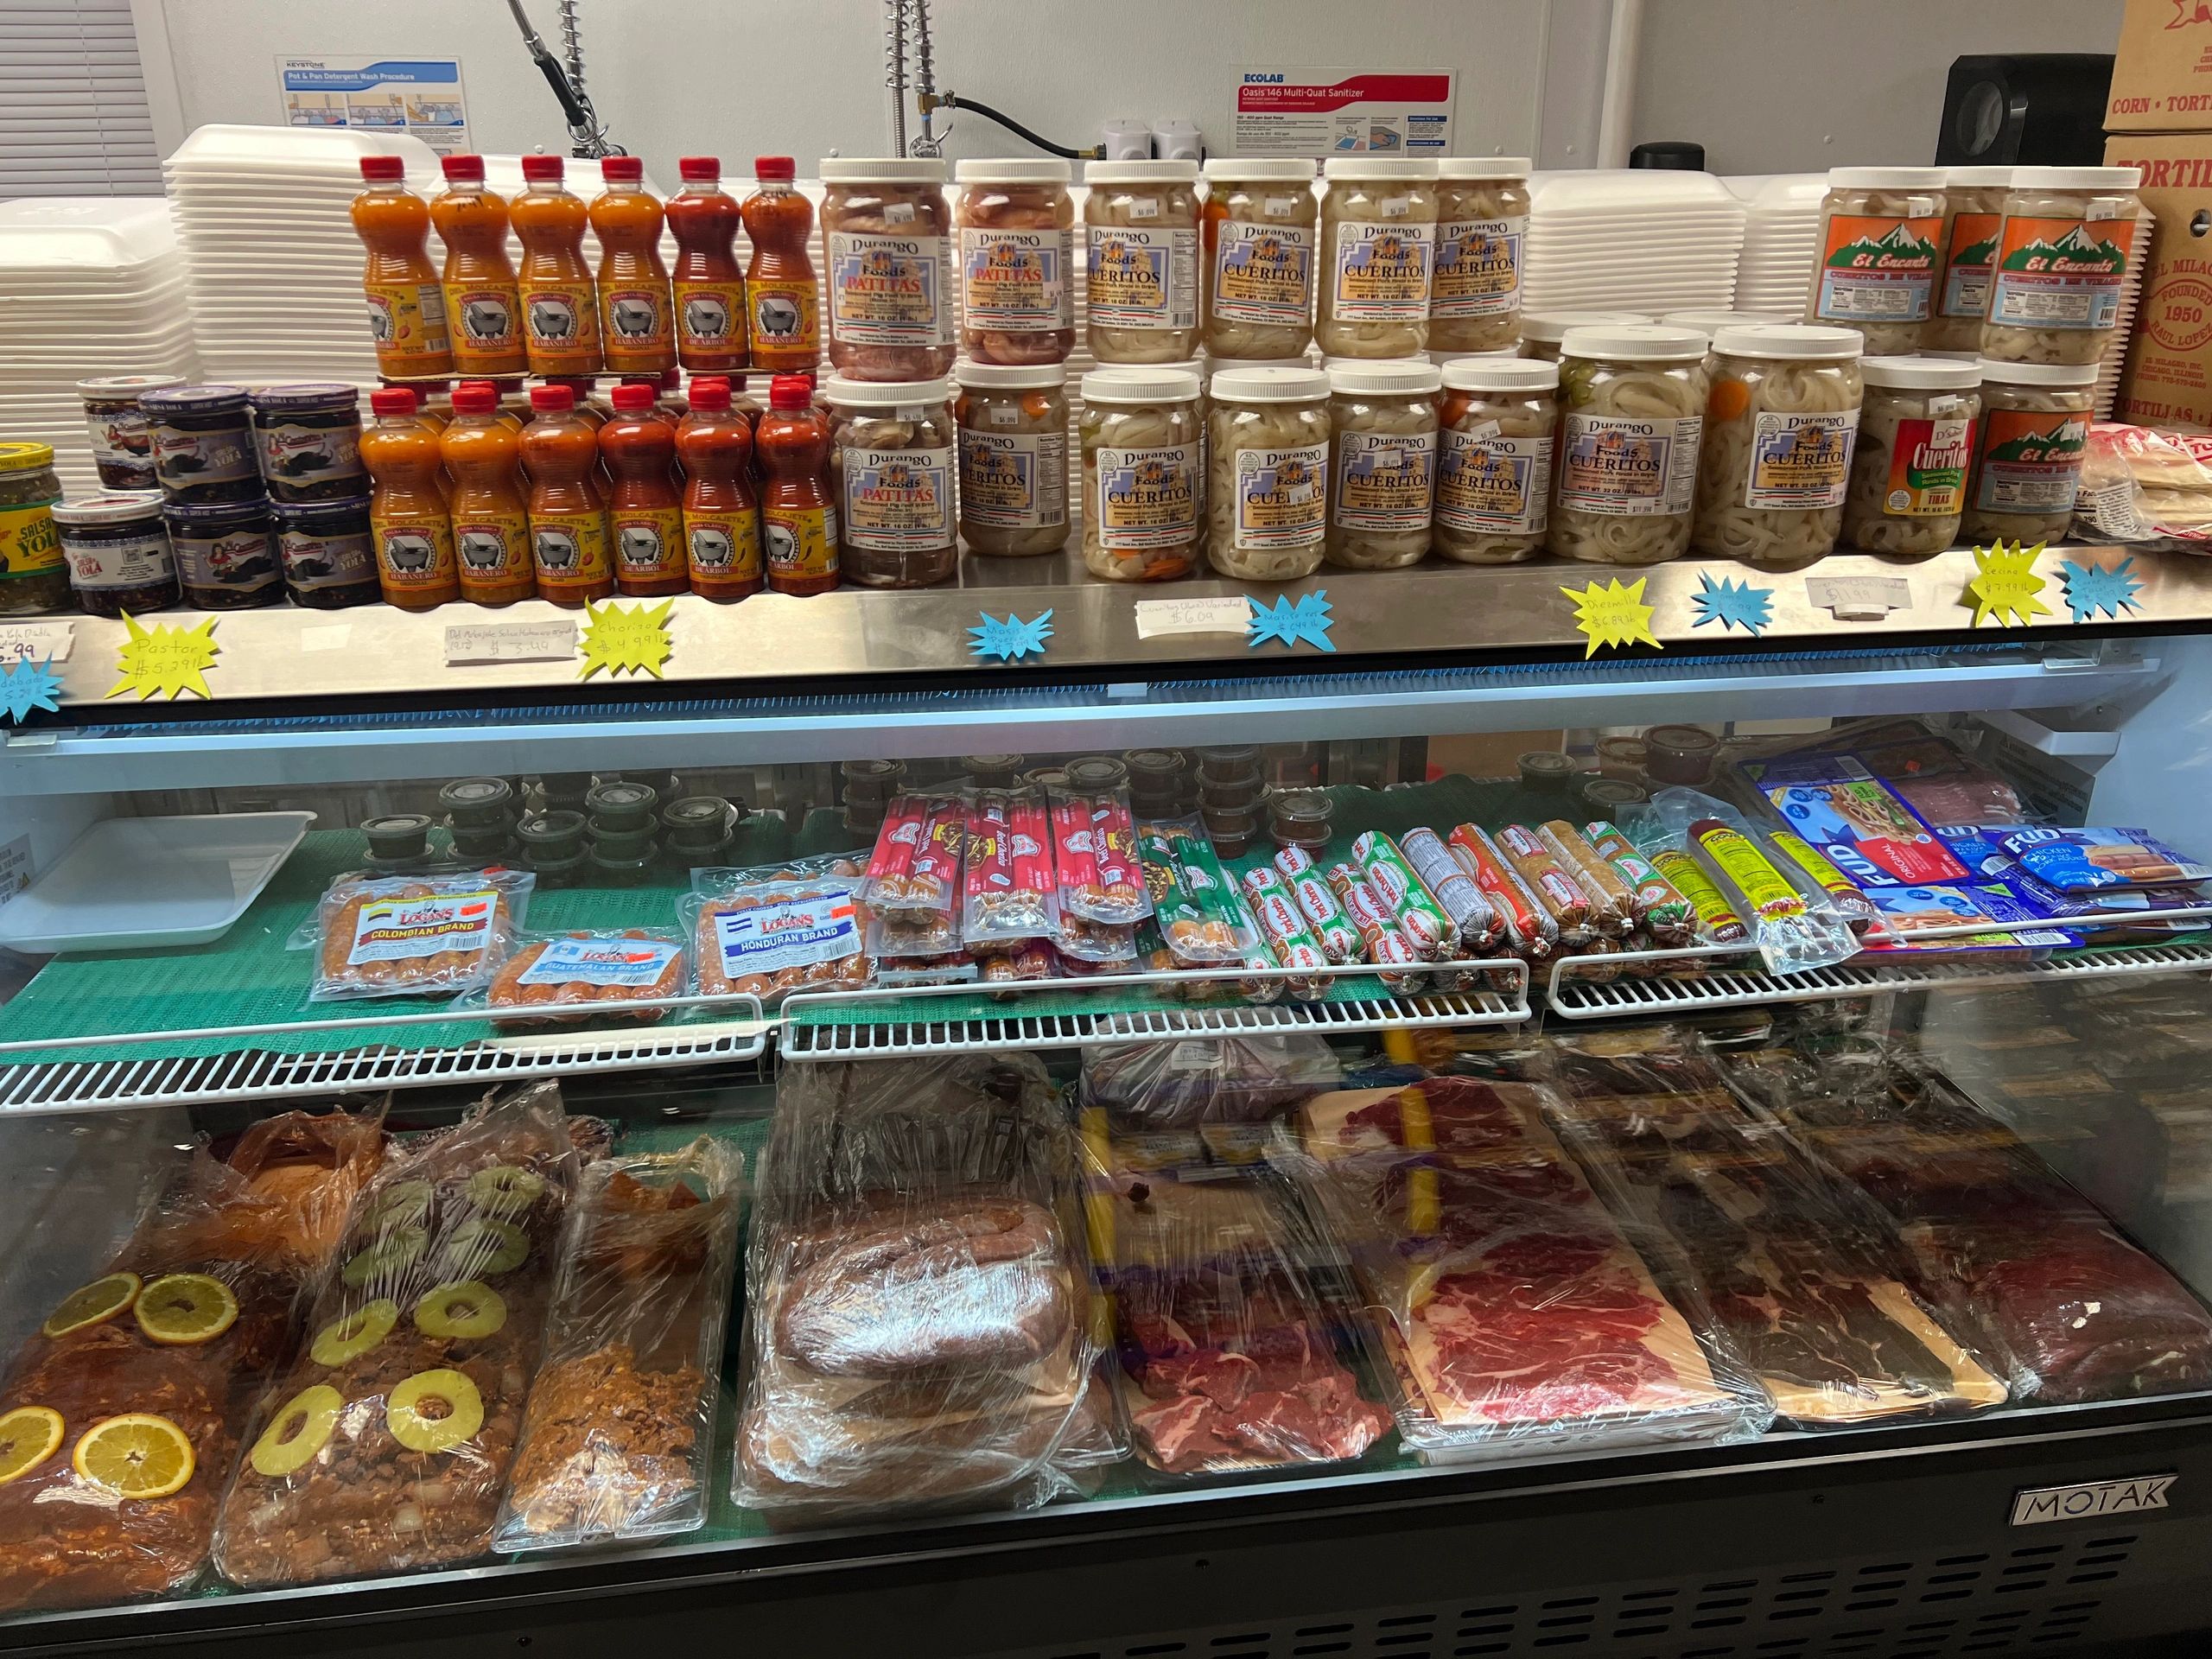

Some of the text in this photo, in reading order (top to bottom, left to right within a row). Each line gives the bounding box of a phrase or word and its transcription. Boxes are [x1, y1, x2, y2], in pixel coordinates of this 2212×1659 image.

[324, 73, 359, 81] Detergent
[1244, 73, 1284, 83] ECOLAB
[1243, 87, 1364, 98] Oasis 146 Multi-Quat Sanitizer
[2112, 95, 2212, 114] CORN TORT
[2117, 160, 2212, 188] ORTIL
[1244, 227, 1301, 243] Durango
[1364, 226, 1421, 239] Durango
[1450, 222, 1508, 238] Durango
[980, 233, 1040, 247] Durango
[1096, 231, 1149, 245] Durango
[852, 238, 918, 254] Durango
[1459, 246, 1497, 257] Foods
[1102, 254, 1136, 264] Foods
[1252, 250, 1288, 262] Foods
[1373, 250, 1410, 259] Foods
[1853, 253, 1931, 269] El Encanto
[989, 257, 1028, 268] Foods
[1434, 257, 1515, 276] CUERITOS
[2025, 257, 2113, 272] El Encanto
[863, 264, 906, 277] Foods
[975, 267, 1042, 282] PATITAS
[1224, 264, 1306, 282] CUERITOS
[1344, 264, 1425, 277] CUERITOS
[846, 276, 920, 293] PATITAS
[2161, 284, 2212, 308] FOUNDED
[2164, 305, 2203, 324] 1950
[2152, 320, 2174, 345] RAUL
[468, 339, 515, 347] HABANERO
[760, 336, 802, 345] HABANERO
[2120, 397, 2193, 423] ORTILLAS
[1590, 421, 1653, 435] Durango
[1788, 416, 1845, 429] Durango
[963, 433, 1014, 449] Durango
[1369, 437, 1425, 449] Durango
[1455, 436, 1516, 454] Duango
[1795, 441, 1833, 452] Foods
[1125, 450, 1184, 466] Durango
[1266, 449, 1322, 466] Durango
[1597, 446, 1639, 457] Foods
[1764, 450, 1847, 466] CUERITOS
[1913, 441, 1969, 470] Cueritos
[2018, 448, 2040, 461] El
[869, 454, 931, 467] Durango
[969, 456, 1001, 467] Foods
[1382, 461, 1414, 470] ods
[1462, 460, 1500, 472] Foods
[1569, 454, 1660, 473] CUERITOS
[880, 477, 920, 488] Foods
[960, 469, 1026, 486] UERITOS
[1135, 475, 1174, 486] Foods
[1276, 475, 1313, 486] Foods
[1347, 473, 1428, 487] CUERITOS
[1440, 472, 1522, 492] CUERITOS
[863, 487, 933, 502] PATITAS
[1108, 487, 1192, 505] CUERITOS
[1247, 486, 1325, 505] CUEOS
[1928, 494, 1949, 505] TIRAS
[20, 518, 52, 539] SALSA
[76, 563, 104, 578] YOLA
[390, 571, 437, 581] HABANERO
[1985, 566, 2018, 575] Cecina
[599, 621, 652, 632] Chorizo
[135, 639, 198, 653] Pastor
[2004, 830, 2060, 854] FUD
[1881, 842, 1916, 879] ORIGINAL
[2024, 848, 2071, 863] CHICKEN
[1827, 844, 1902, 886] FUD
[400, 908, 455, 925] LOGAN'S
[761, 913, 815, 931] LOGAN'S
[371, 923, 474, 939] COLOMBIAN BRAND
[741, 926, 838, 951] HONDURAN BRAND
[545, 962, 654, 971] GUATEMALAN BRAND
[2022, 1480, 2166, 1522] MOTAK
